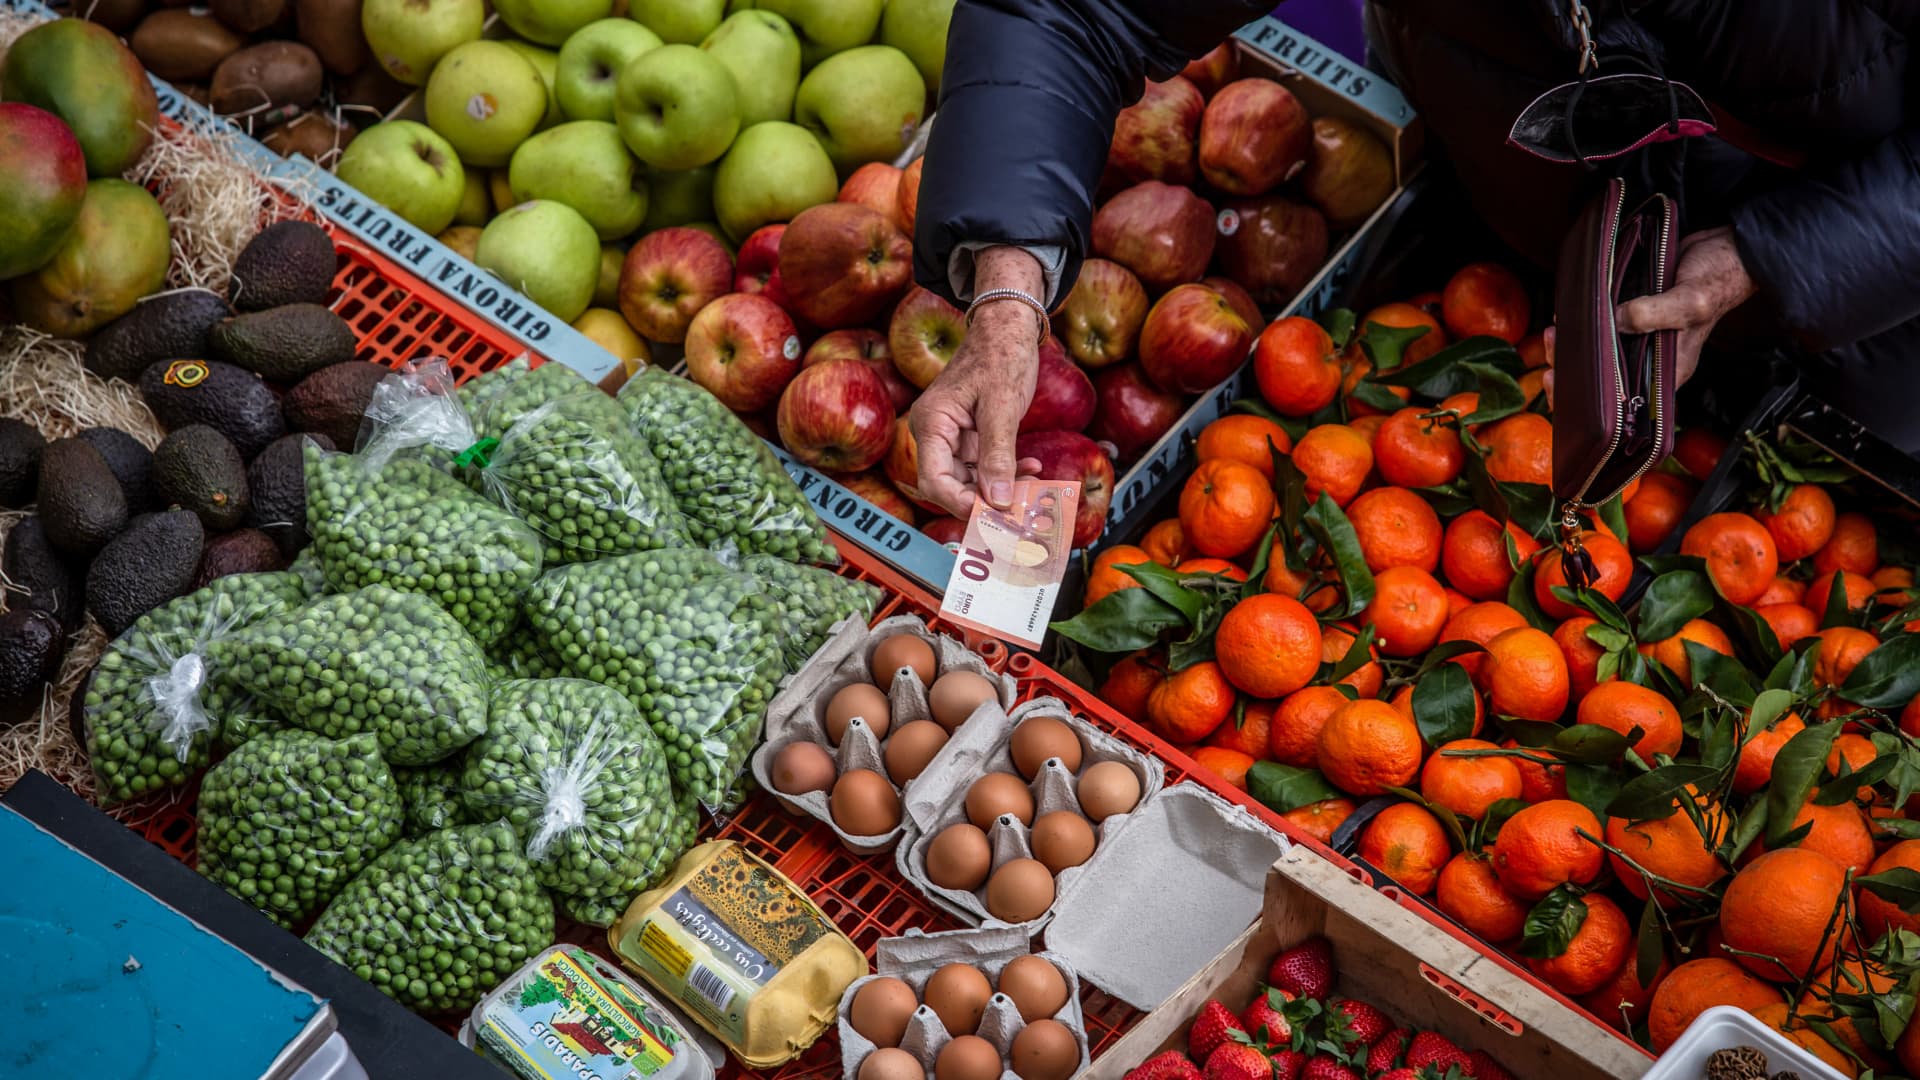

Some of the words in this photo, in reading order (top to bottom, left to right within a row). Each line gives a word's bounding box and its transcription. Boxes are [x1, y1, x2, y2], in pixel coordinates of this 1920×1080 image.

[1252, 25, 1371, 97] FRUITS
[318, 186, 433, 265] FRUITS
[438, 260, 551, 341] GIRONA
[799, 471, 912, 552] GIRONA
[960, 547, 994, 582] 10
[962, 593, 974, 615] EURO
[597, 996, 642, 1038] AGRICULTURA
